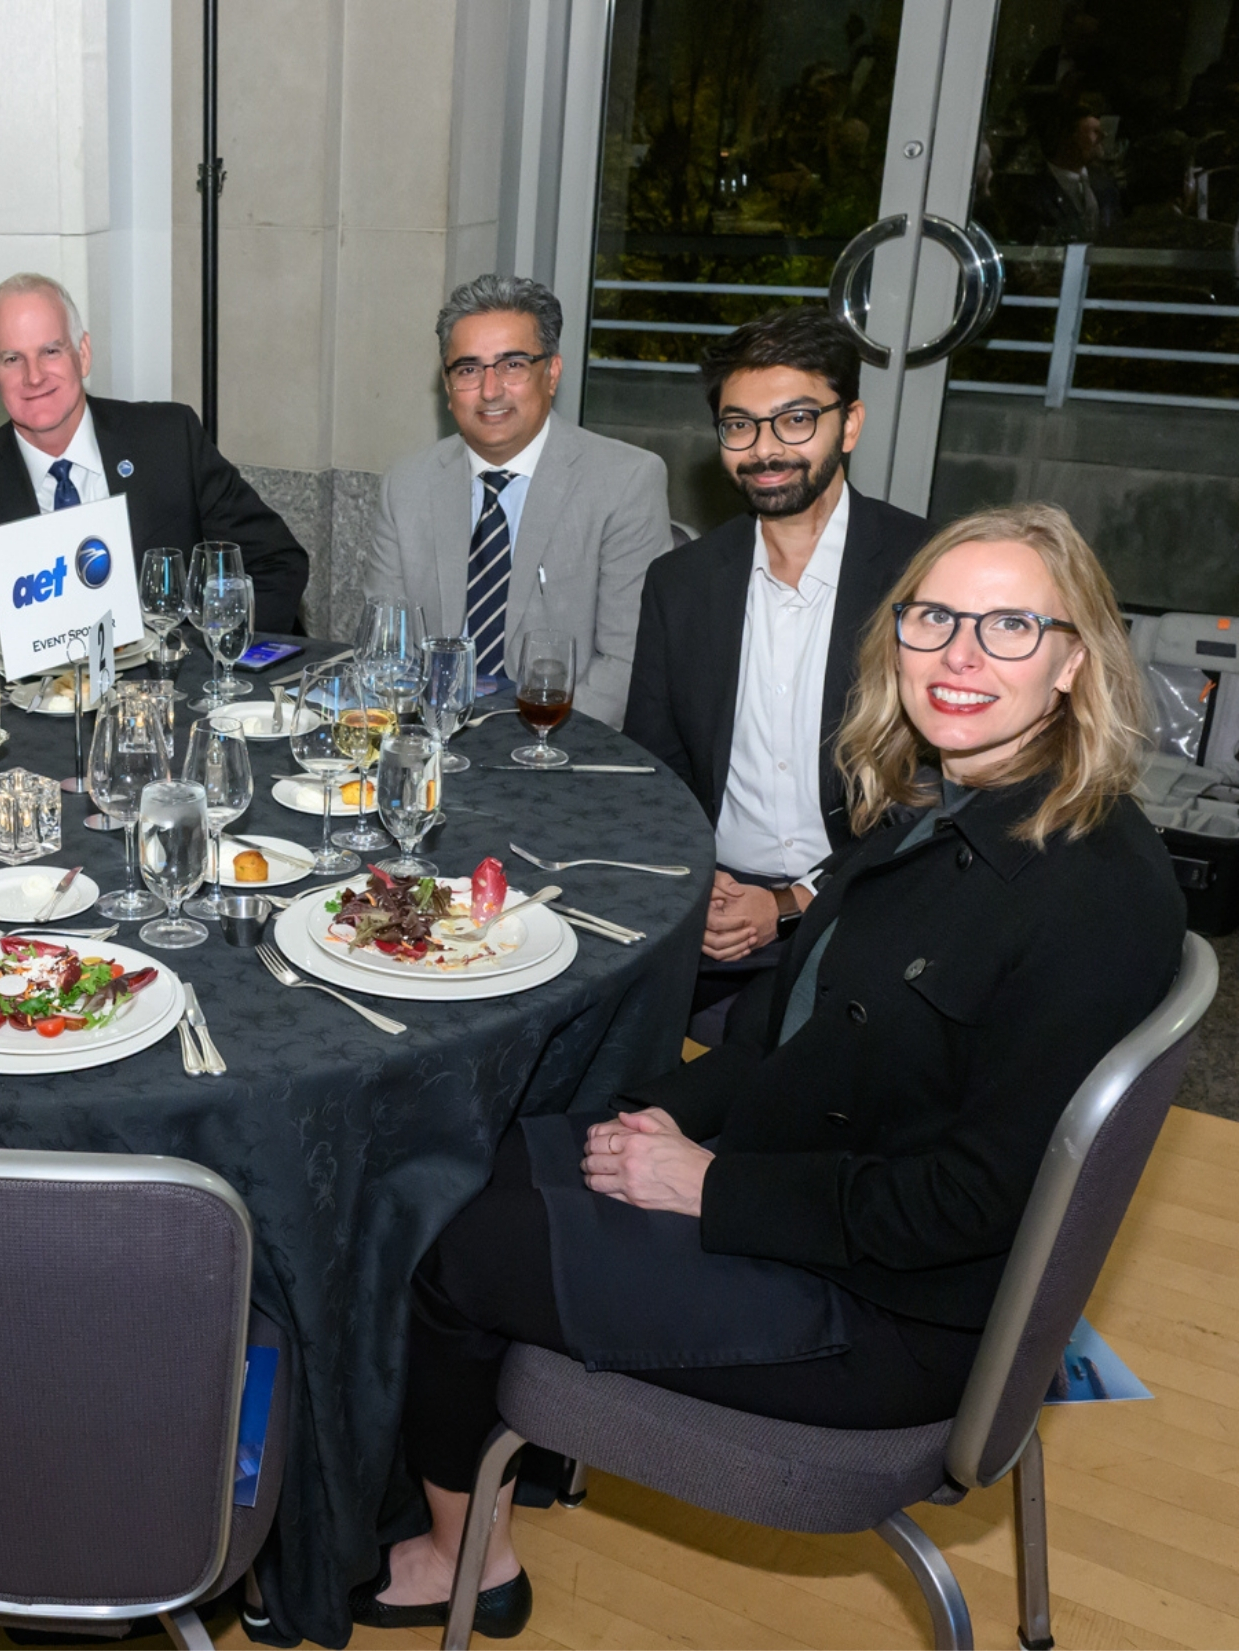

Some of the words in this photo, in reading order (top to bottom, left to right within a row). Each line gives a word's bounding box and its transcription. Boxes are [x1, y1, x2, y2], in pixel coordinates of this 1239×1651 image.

[13, 556, 67, 609] aet
[33, 634, 66, 652] EVENT
[98, 622, 106, 672] 2
